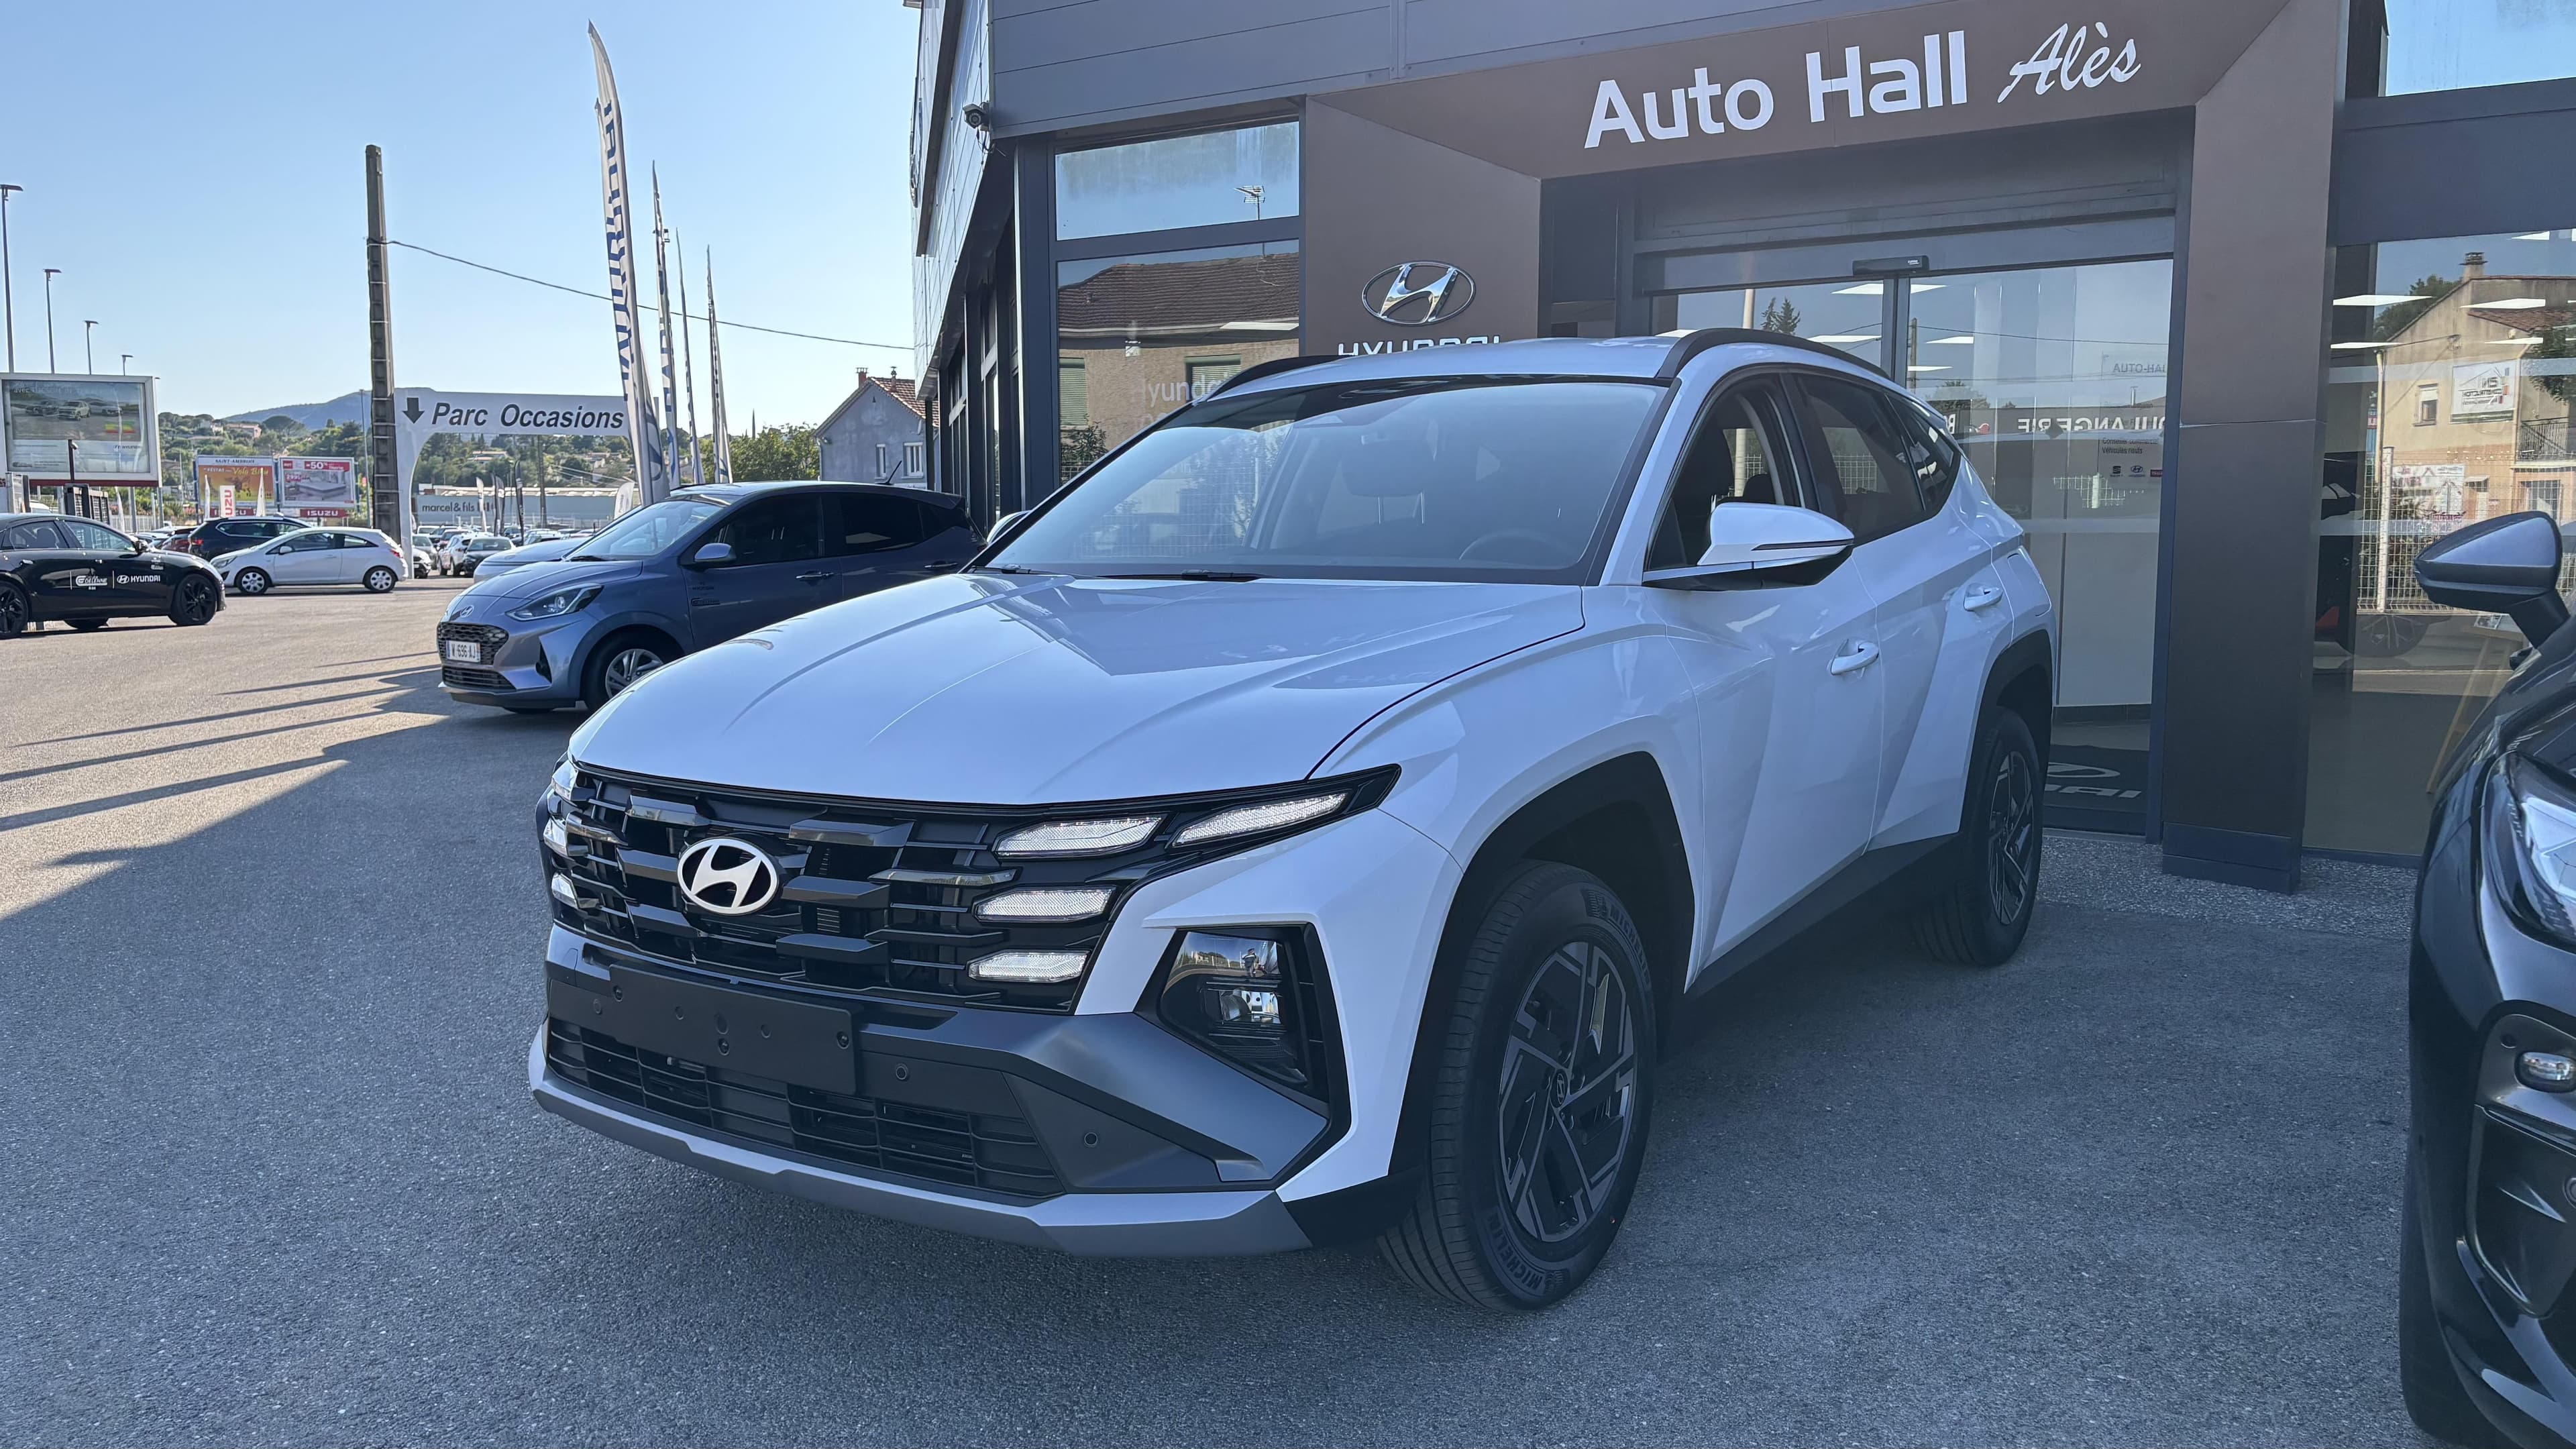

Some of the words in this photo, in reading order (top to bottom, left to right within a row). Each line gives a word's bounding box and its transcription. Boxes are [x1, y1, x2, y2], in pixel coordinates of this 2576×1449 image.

[1584, 67, 1774, 149] Auto
[1806, 30, 1968, 123] Hall
[1997, 21, 2141, 103] Alès
[431, 402, 488, 426] Parc
[500, 403, 624, 429] Occasions
[422, 502, 453, 512] marcel
[462, 502, 475, 512] fils
[131, 575, 160, 583] HYUNDAI
